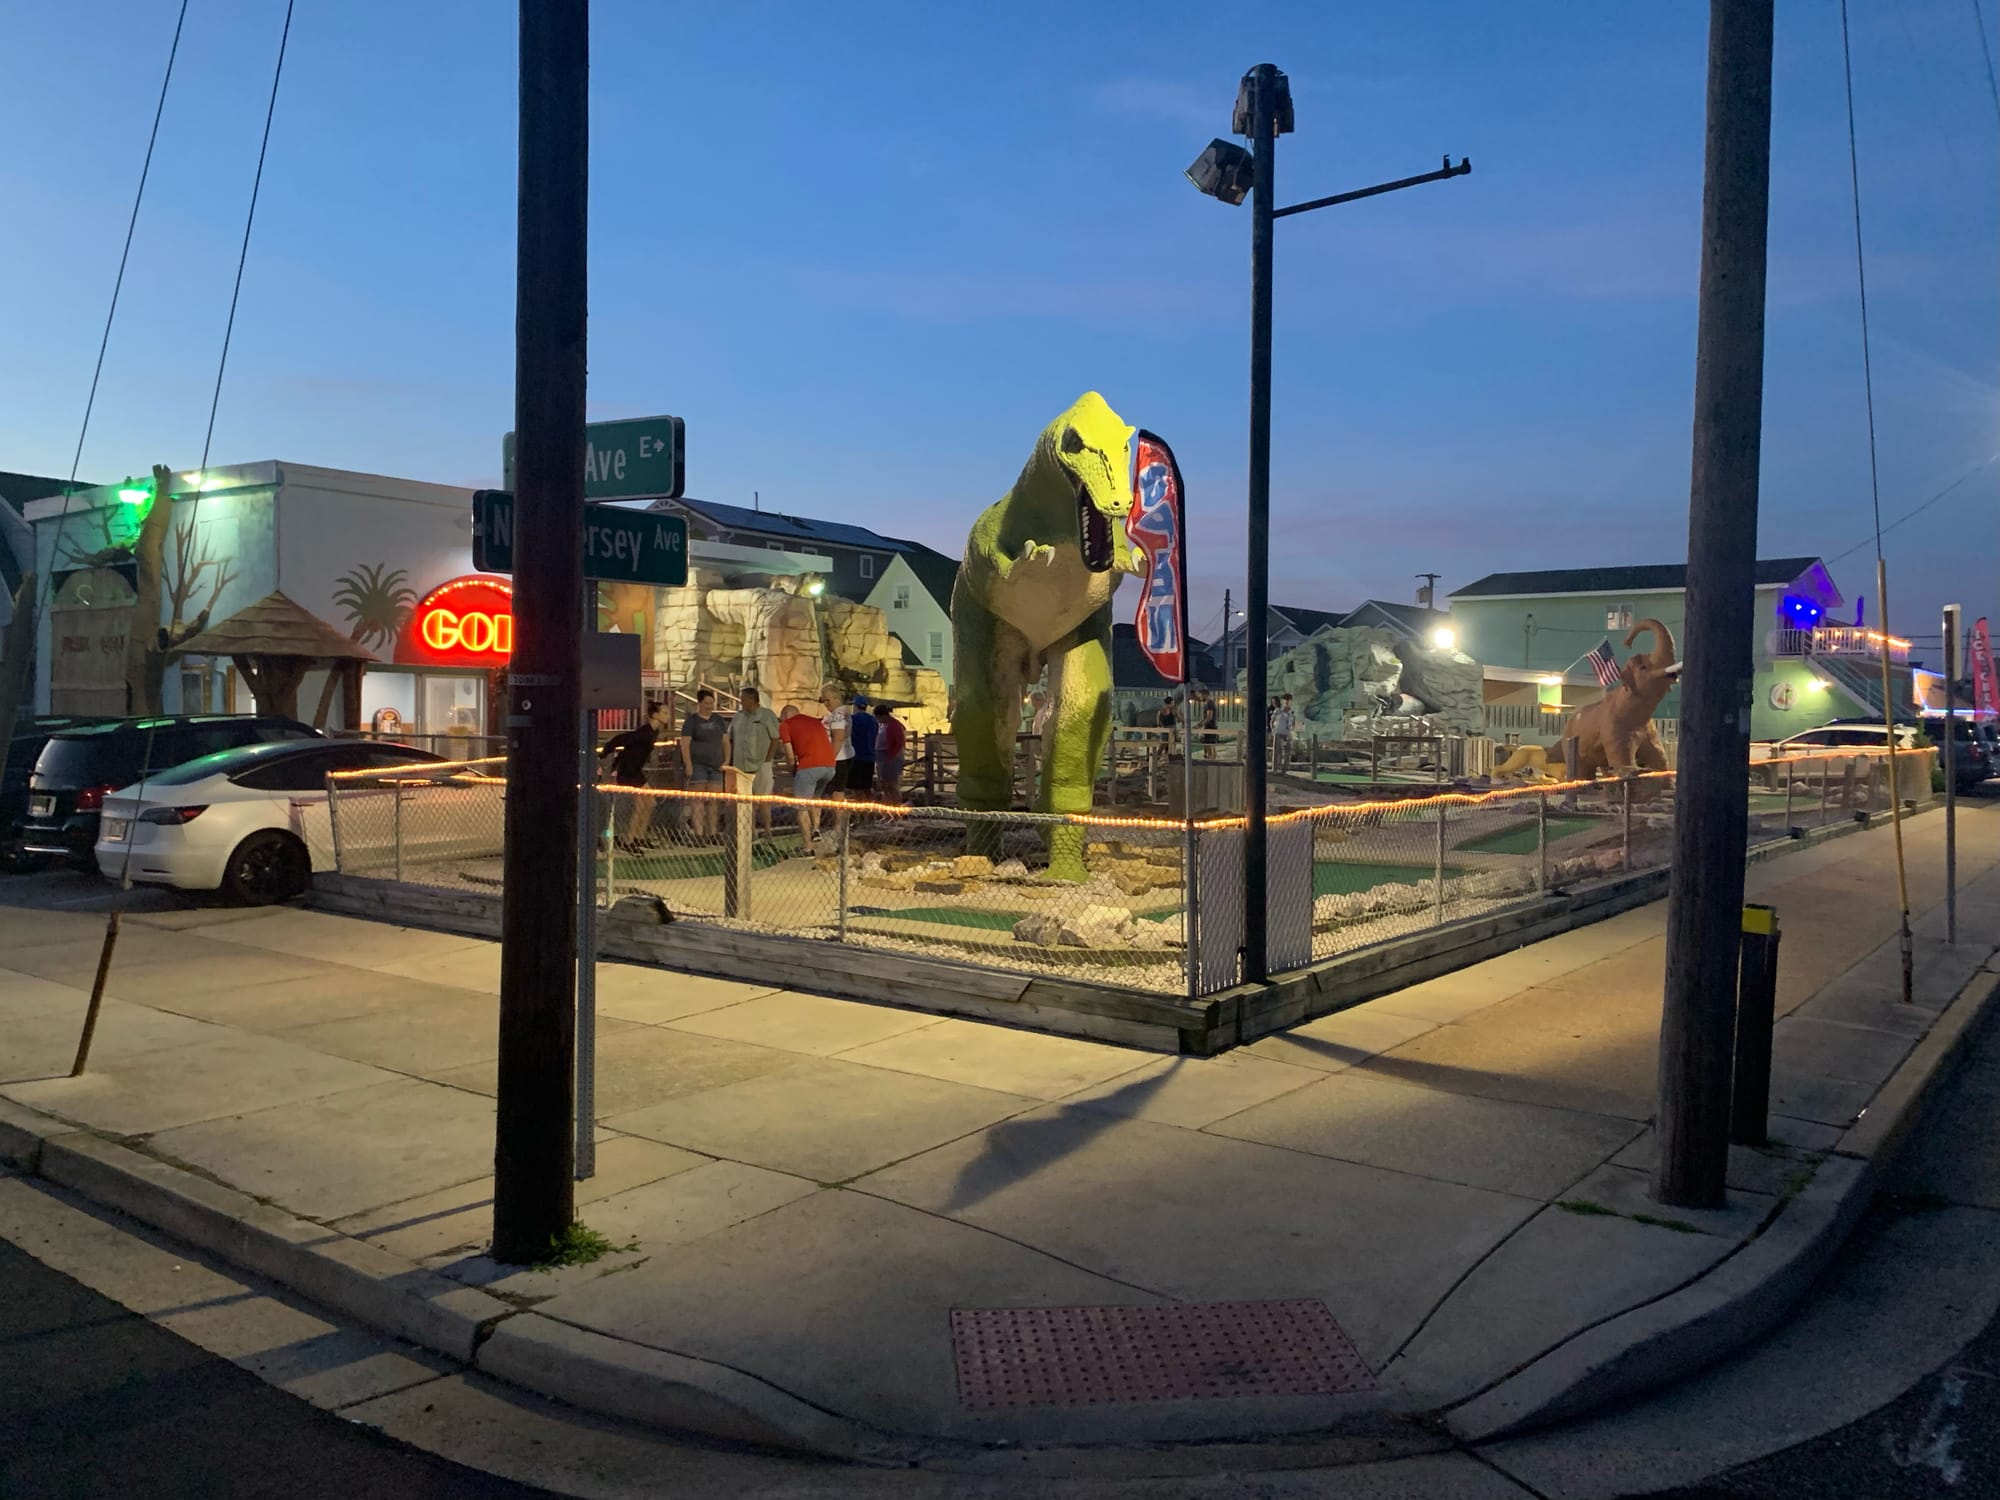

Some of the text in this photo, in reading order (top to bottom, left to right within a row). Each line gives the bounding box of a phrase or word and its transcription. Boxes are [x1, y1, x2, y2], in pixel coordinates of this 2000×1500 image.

[585, 436, 652, 482] Ave E
[654, 524, 680, 553] Ave
